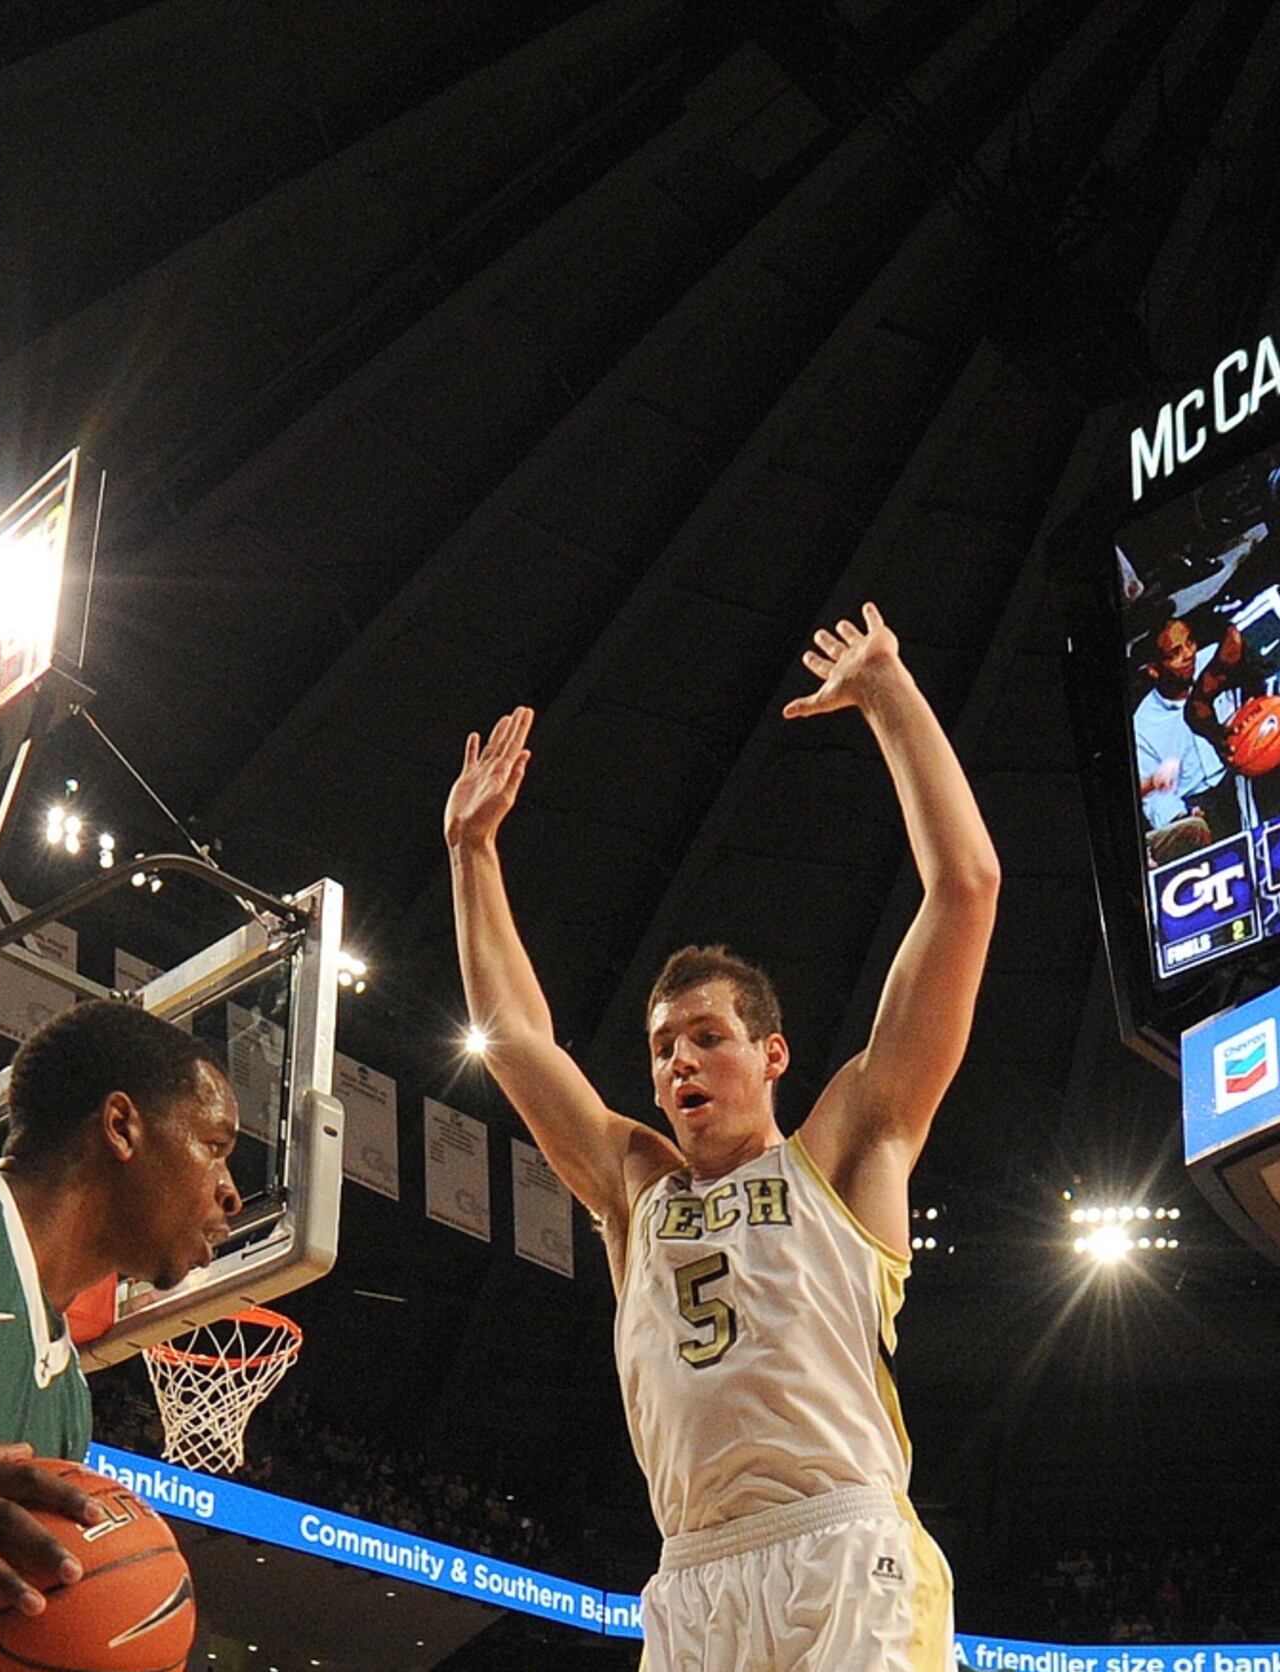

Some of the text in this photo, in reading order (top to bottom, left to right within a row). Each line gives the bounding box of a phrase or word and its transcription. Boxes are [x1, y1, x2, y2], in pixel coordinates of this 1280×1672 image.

[1160, 860, 1246, 918] GT
[1232, 920, 1245, 941] 2
[657, 1178, 791, 1240] ECH
[674, 1253, 737, 1369] 5
[98, 1455, 214, 1518] banking
[300, 1514, 644, 1630] Community & Southern Bank
